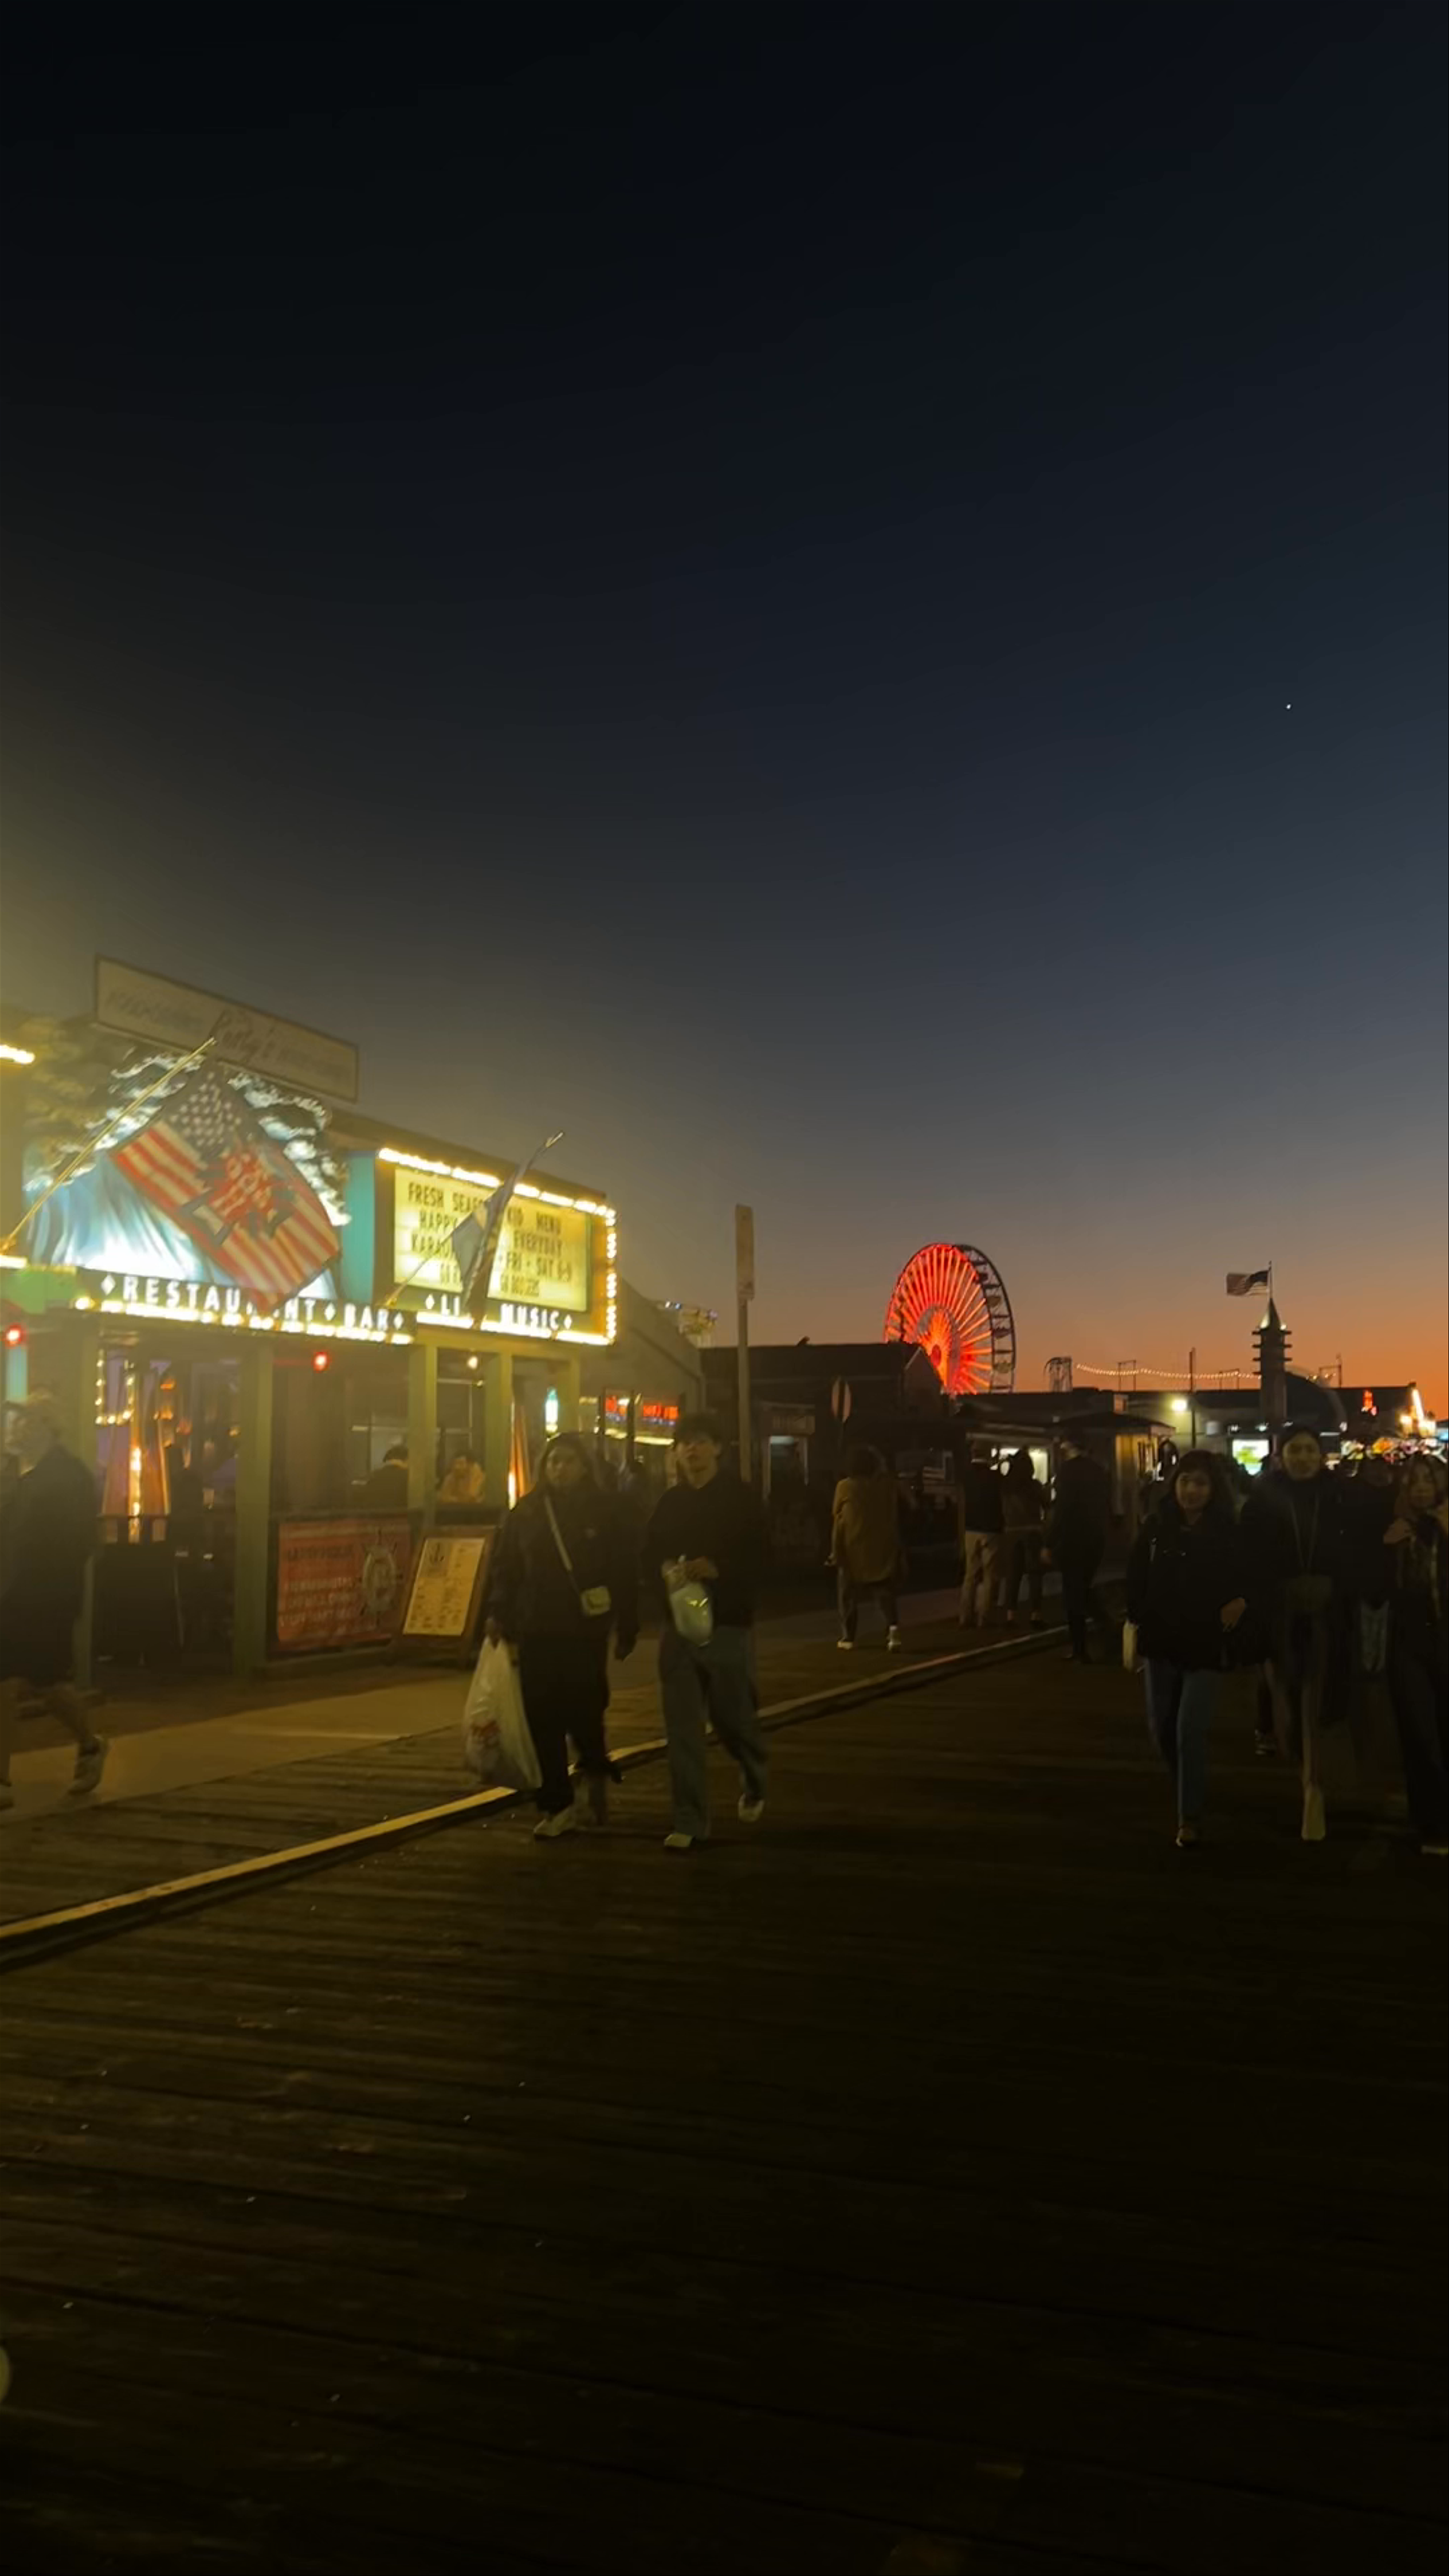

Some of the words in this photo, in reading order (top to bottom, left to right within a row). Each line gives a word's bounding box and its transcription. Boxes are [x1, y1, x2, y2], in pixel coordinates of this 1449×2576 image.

[408, 1182, 444, 1207] FRESH
[123, 1275, 316, 1321] RESTAUNT
[345, 1303, 388, 1331] BAR
[441, 1293, 460, 1317] LI
[501, 1303, 559, 1330] MUSIC
